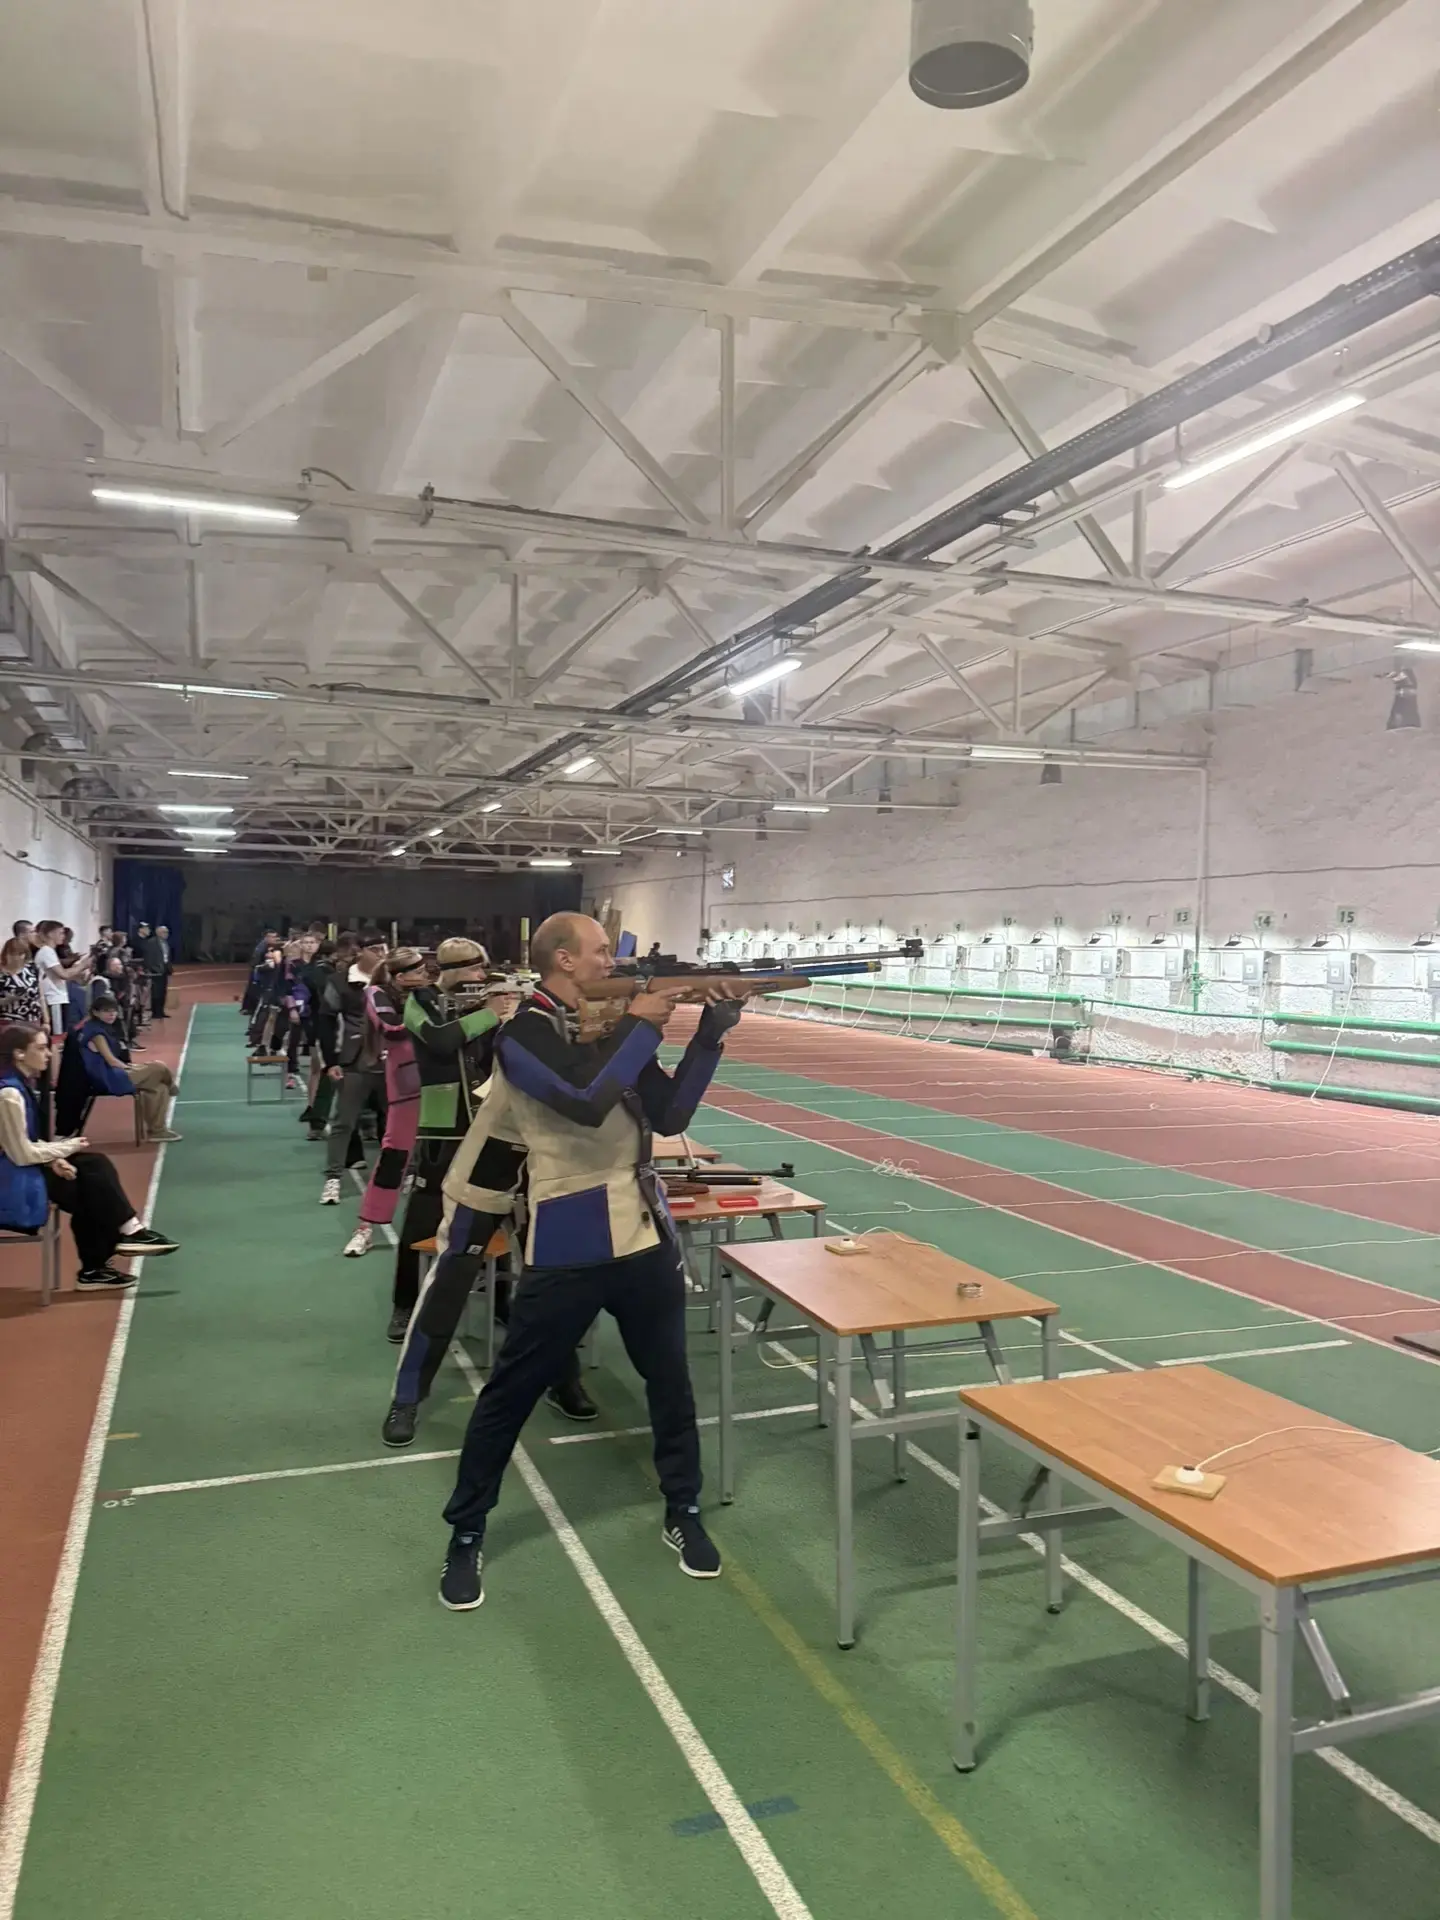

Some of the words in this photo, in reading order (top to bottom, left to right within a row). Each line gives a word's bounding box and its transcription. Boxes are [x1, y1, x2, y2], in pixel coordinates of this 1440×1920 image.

[1003, 917, 1012, 926] 10
[1111, 913, 1121, 925] 12
[1176, 911, 1188, 922] 13
[1258, 915, 1271, 927] 14
[1340, 910, 1354, 923] 15
